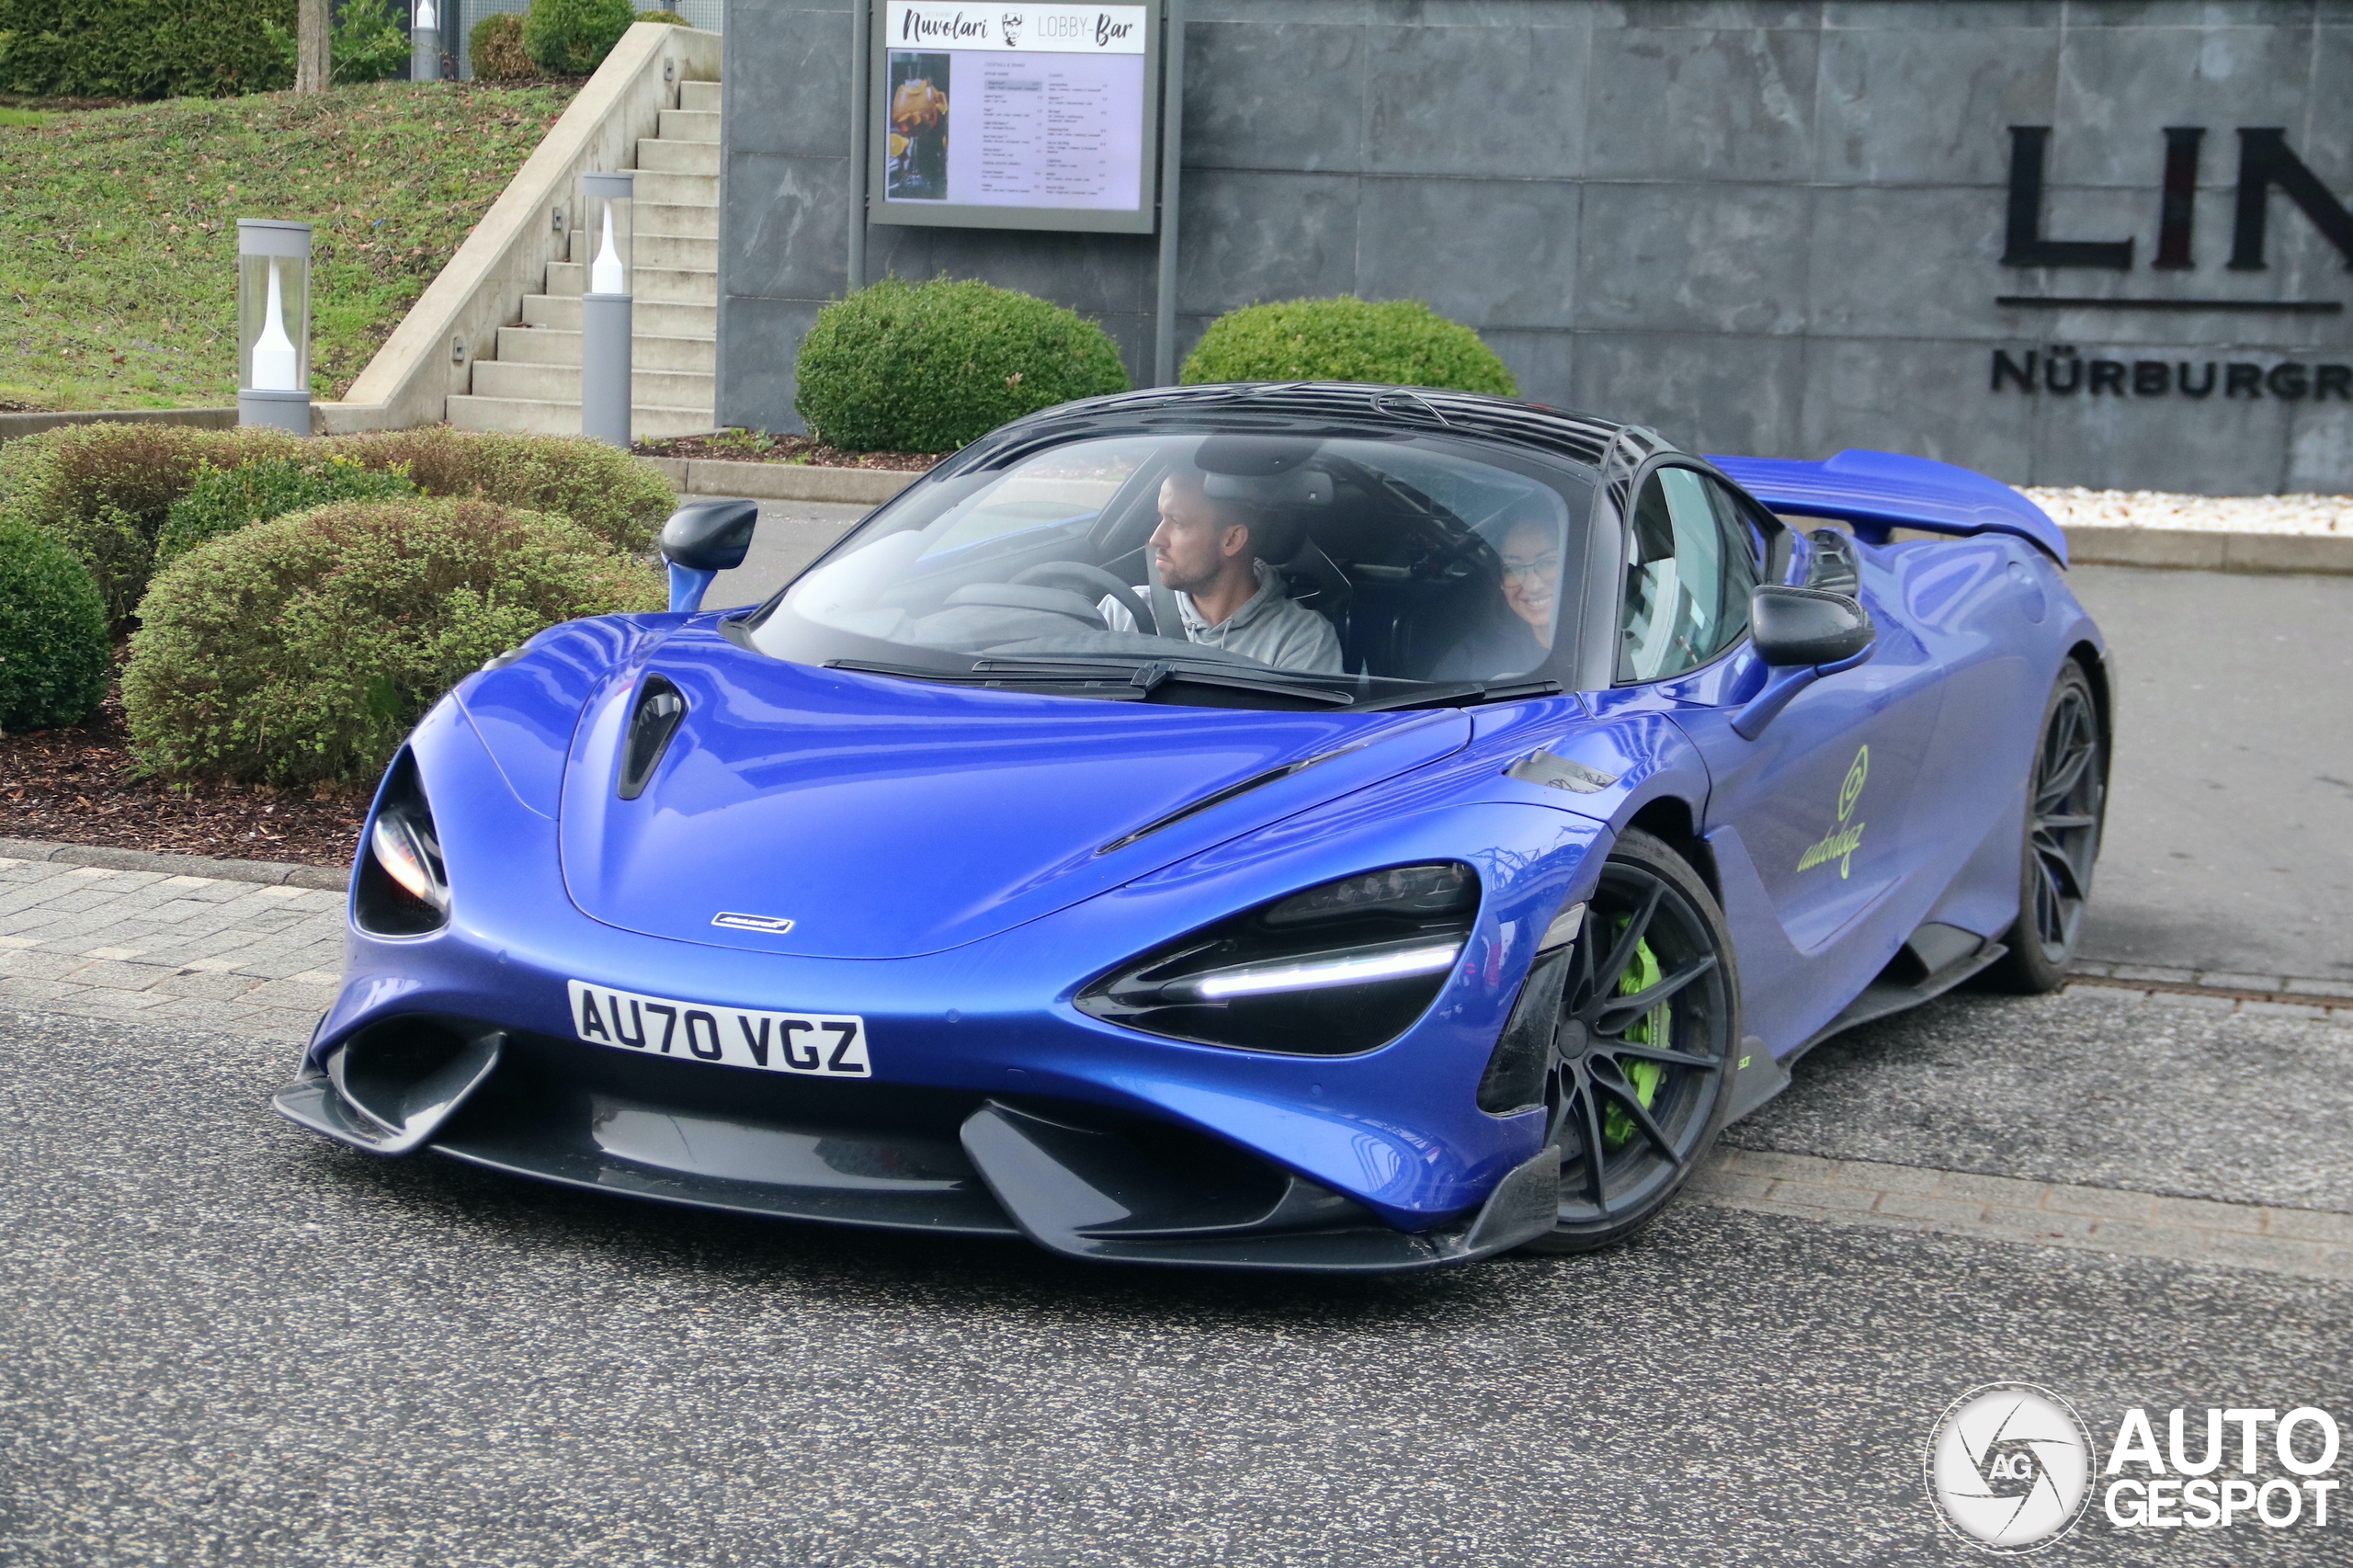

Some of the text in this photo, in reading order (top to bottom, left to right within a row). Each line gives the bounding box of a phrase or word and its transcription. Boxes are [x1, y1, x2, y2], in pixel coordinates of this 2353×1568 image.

[903, 8, 989, 42] Nuvolari
[1990, 345, 2353, 402] NÜRBURGR
[582, 988, 865, 1074] AU70 VGZ
